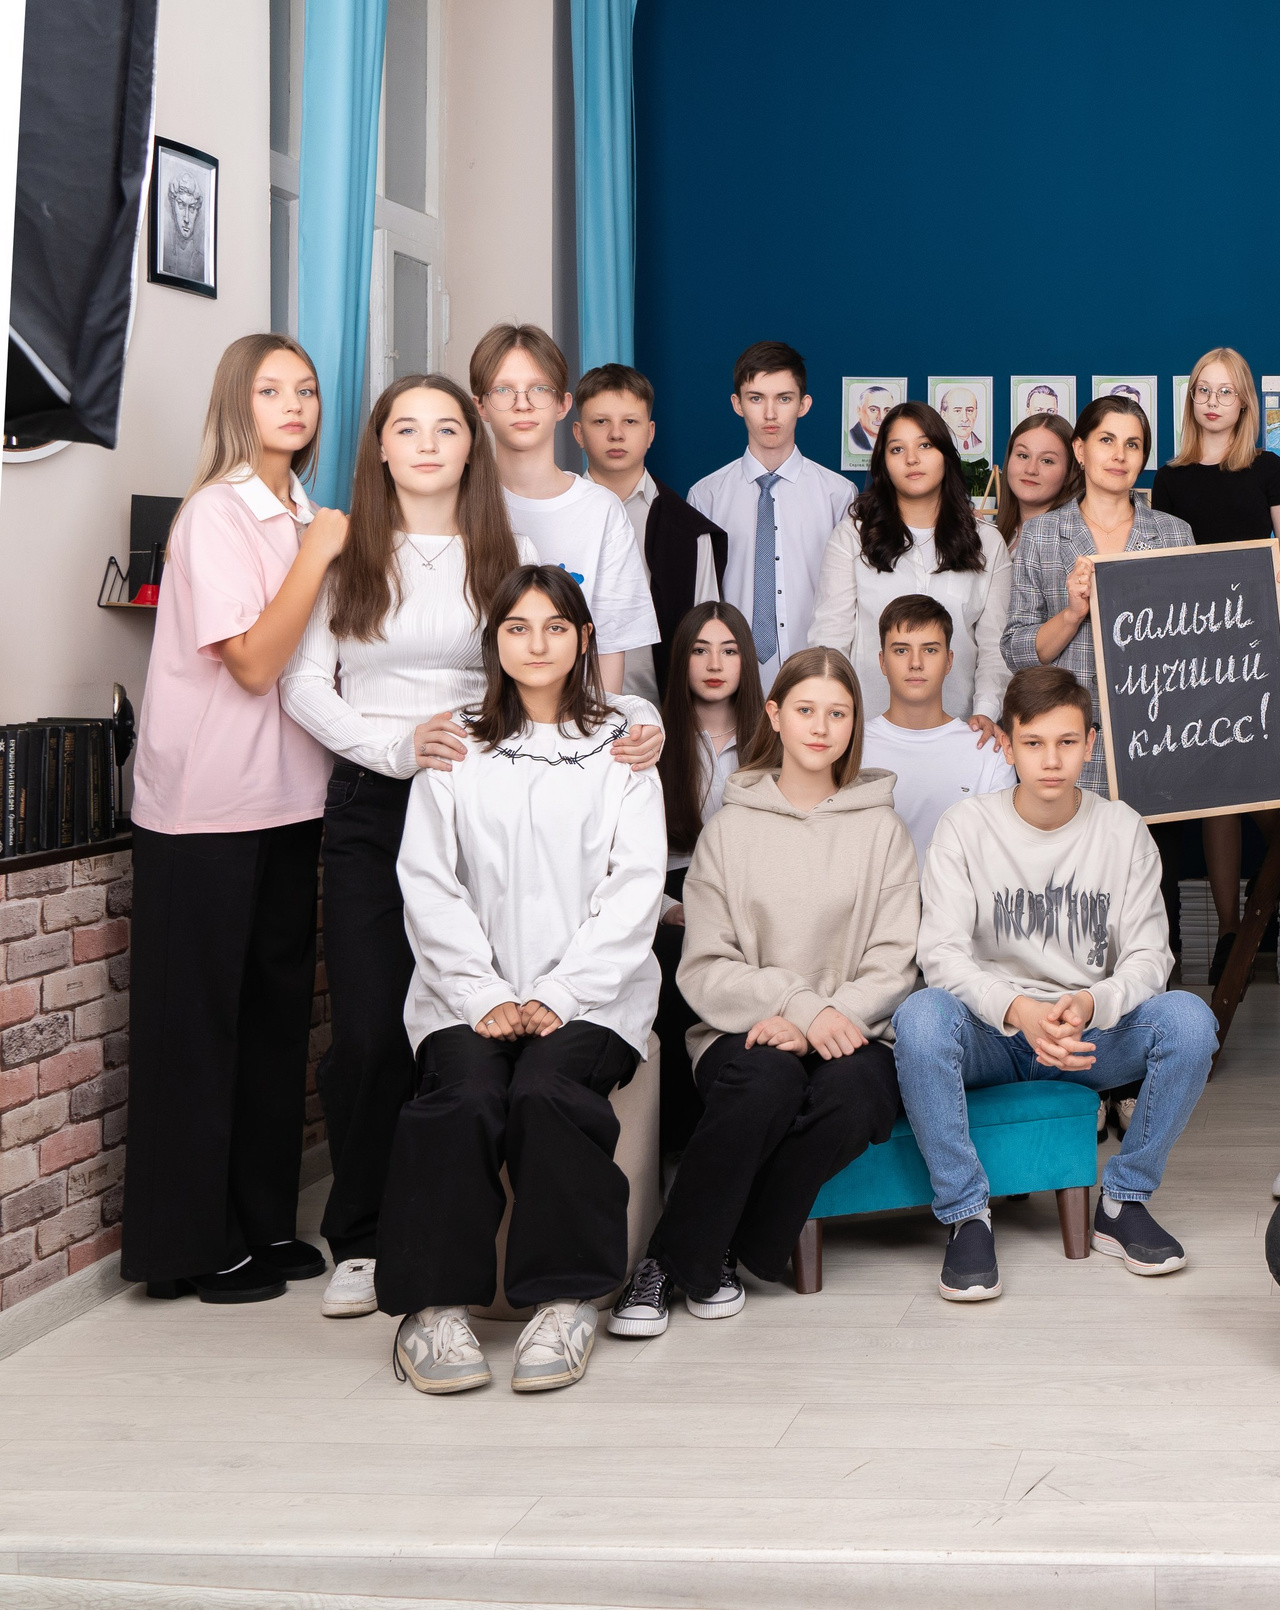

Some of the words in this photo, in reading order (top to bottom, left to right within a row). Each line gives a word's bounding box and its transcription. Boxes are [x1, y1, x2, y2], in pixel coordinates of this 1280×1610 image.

[1112, 582, 1255, 652] самый
[1114, 639, 1269, 722] лучший
[1128, 691, 1271, 761] класс!
